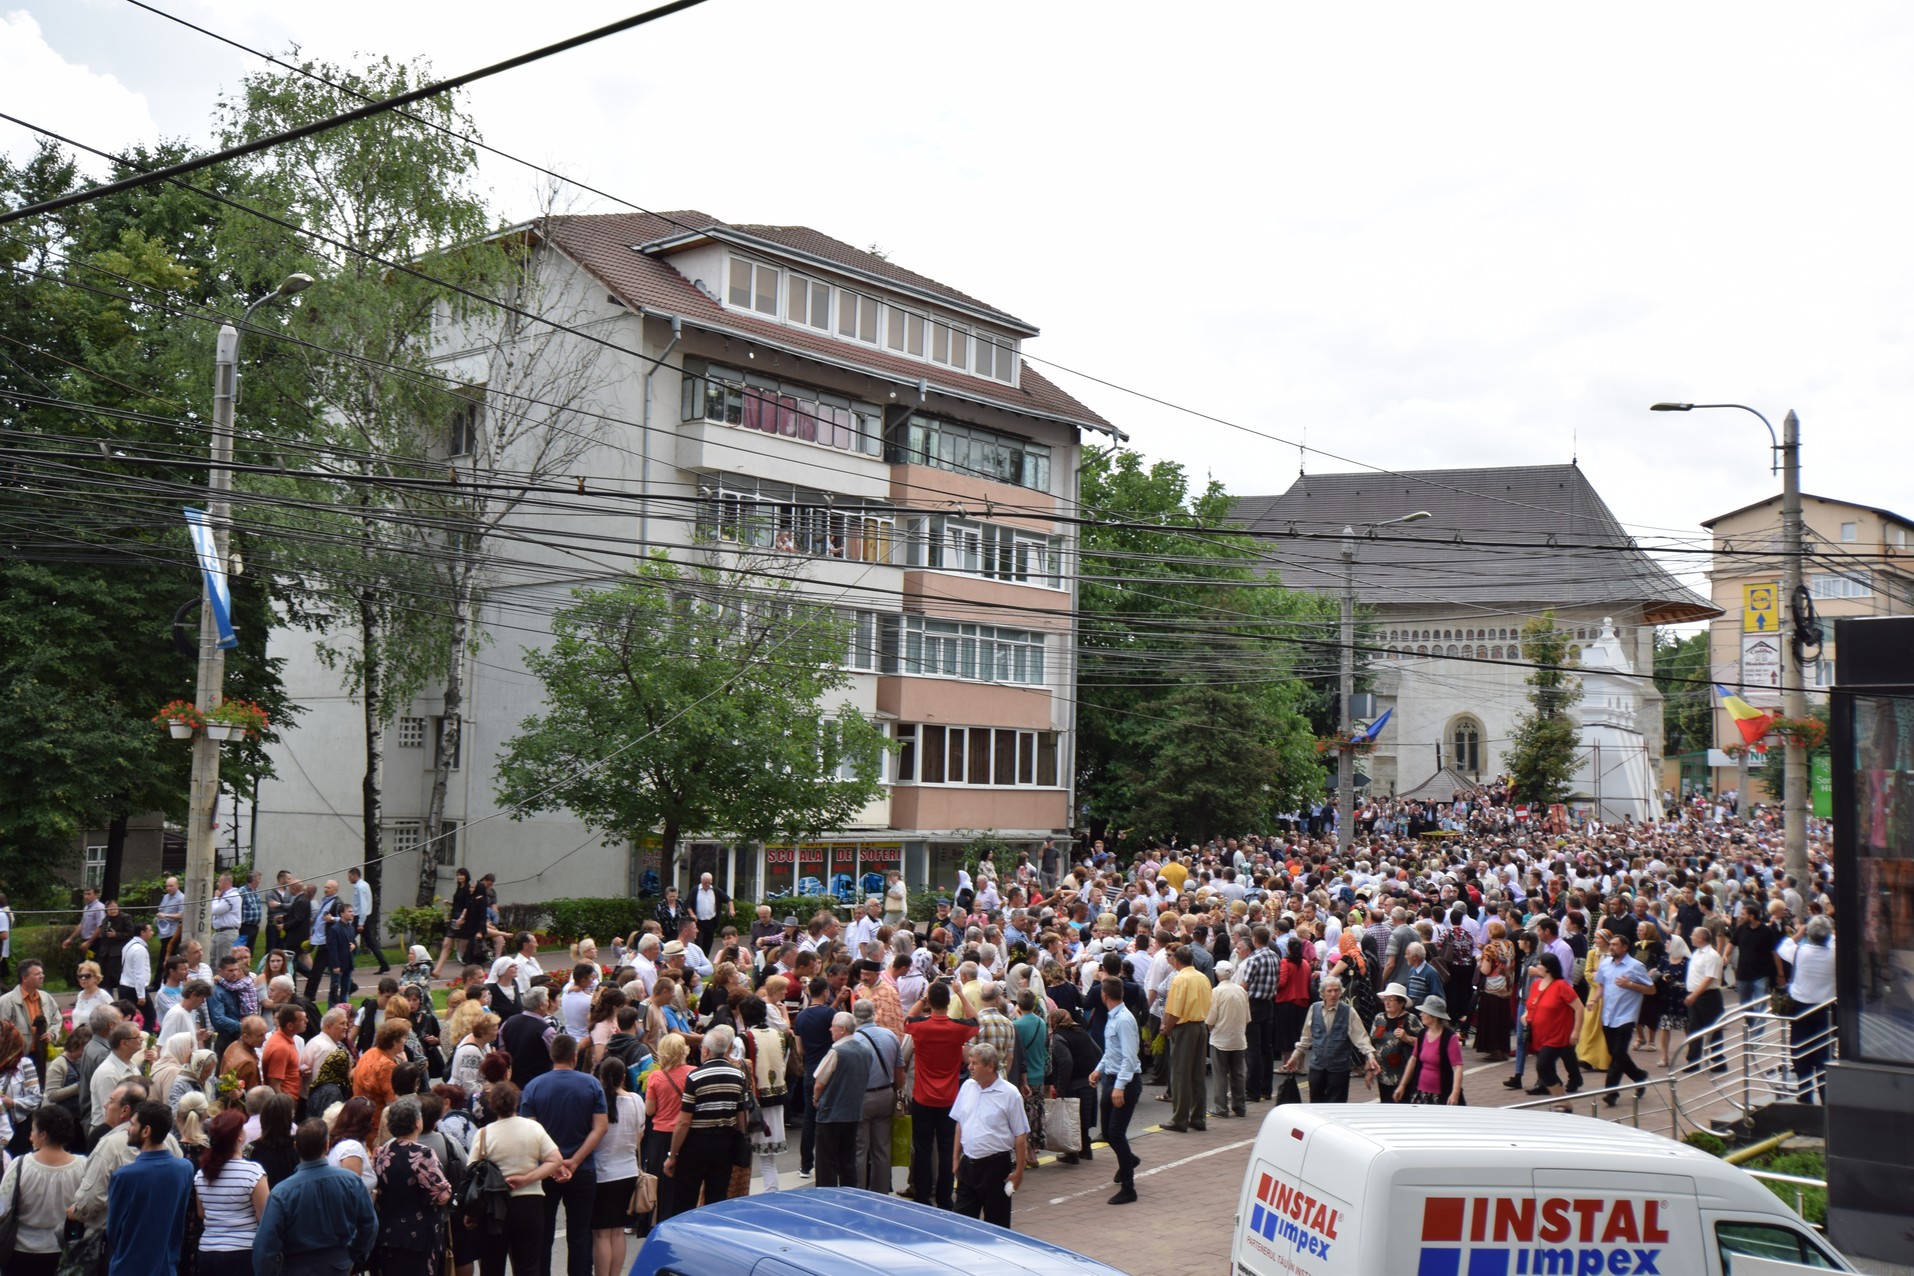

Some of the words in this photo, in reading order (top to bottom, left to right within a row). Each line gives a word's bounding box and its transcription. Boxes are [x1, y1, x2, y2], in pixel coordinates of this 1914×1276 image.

[836, 849, 852, 861] DE
[859, 849, 901, 861] SOFERI
[1269, 1179, 1338, 1241] INSTAL
[1470, 1197, 1669, 1244] INSTAL
